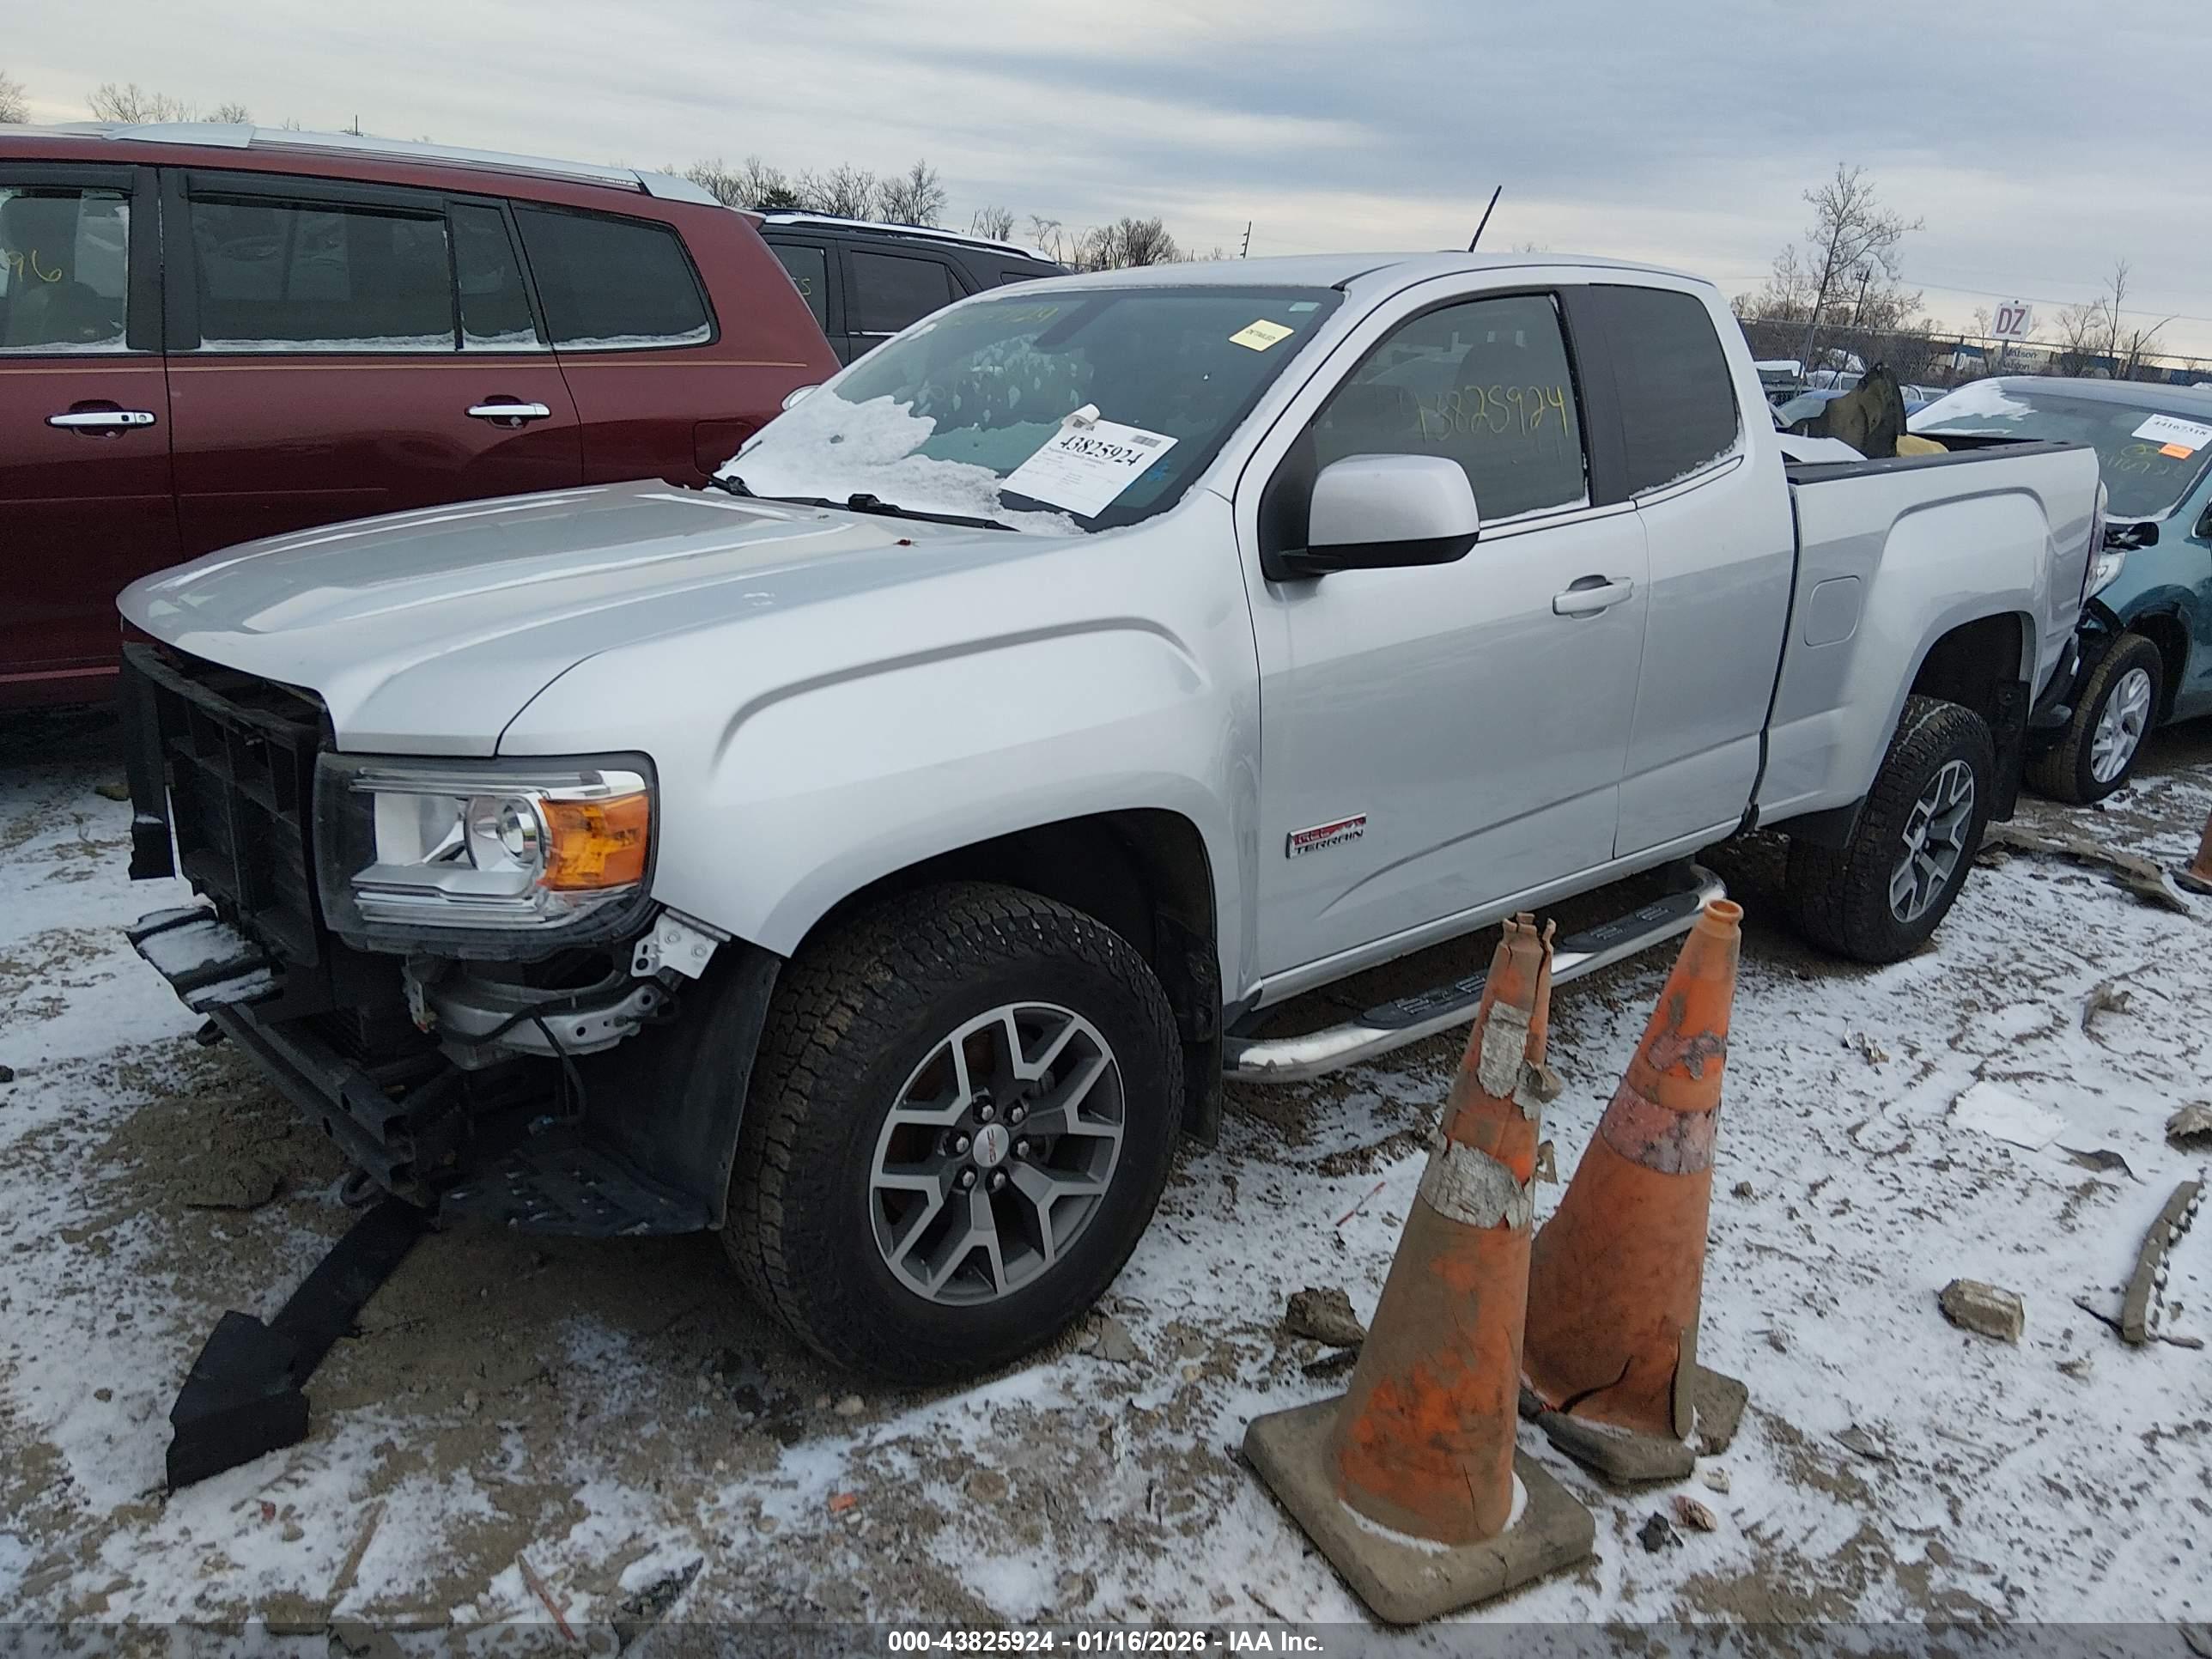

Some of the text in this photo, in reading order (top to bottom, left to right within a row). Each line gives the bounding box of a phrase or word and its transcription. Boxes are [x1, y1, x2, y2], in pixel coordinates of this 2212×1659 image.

[1996, 307, 2027, 335] DZ
[1060, 434, 1145, 466] 43825924
[1297, 830, 1364, 854] TERRAIN
